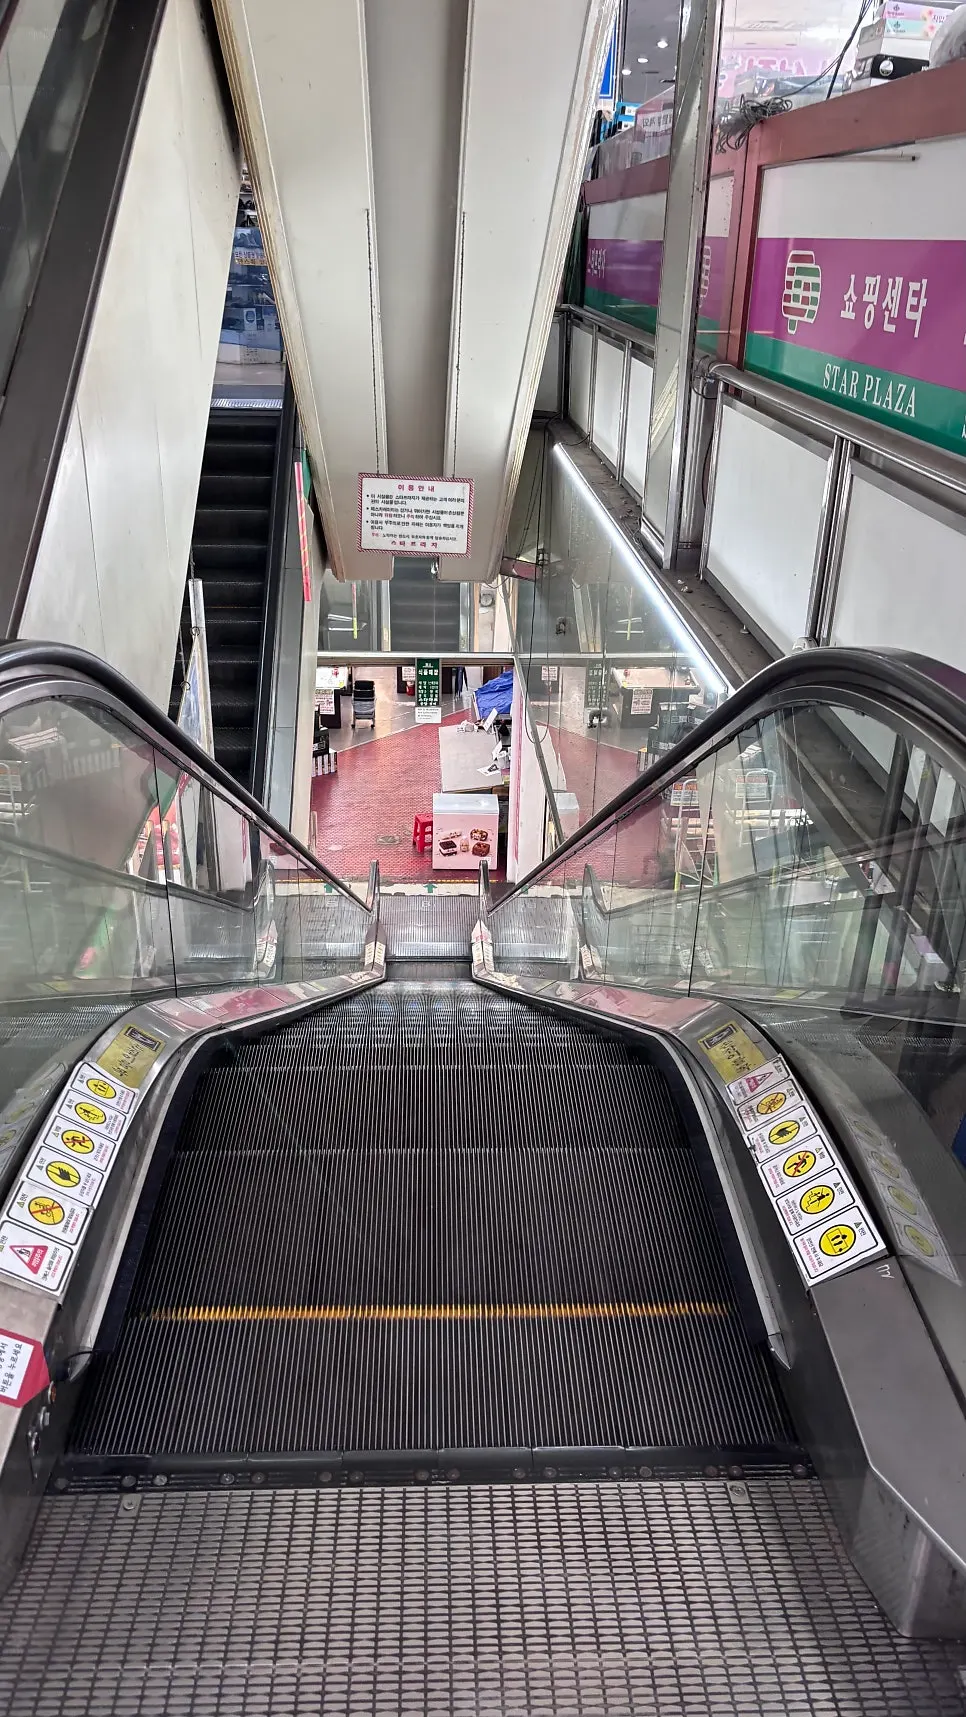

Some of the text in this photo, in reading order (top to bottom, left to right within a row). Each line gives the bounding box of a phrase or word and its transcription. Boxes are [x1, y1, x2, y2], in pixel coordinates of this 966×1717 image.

[840, 274, 928, 338] 쇼핑센타
[822, 364, 916, 418] STAR PLAZA
[8, 1344, 23, 1370] 누르세요
[0, 1372, 15, 1393] 버튼을
